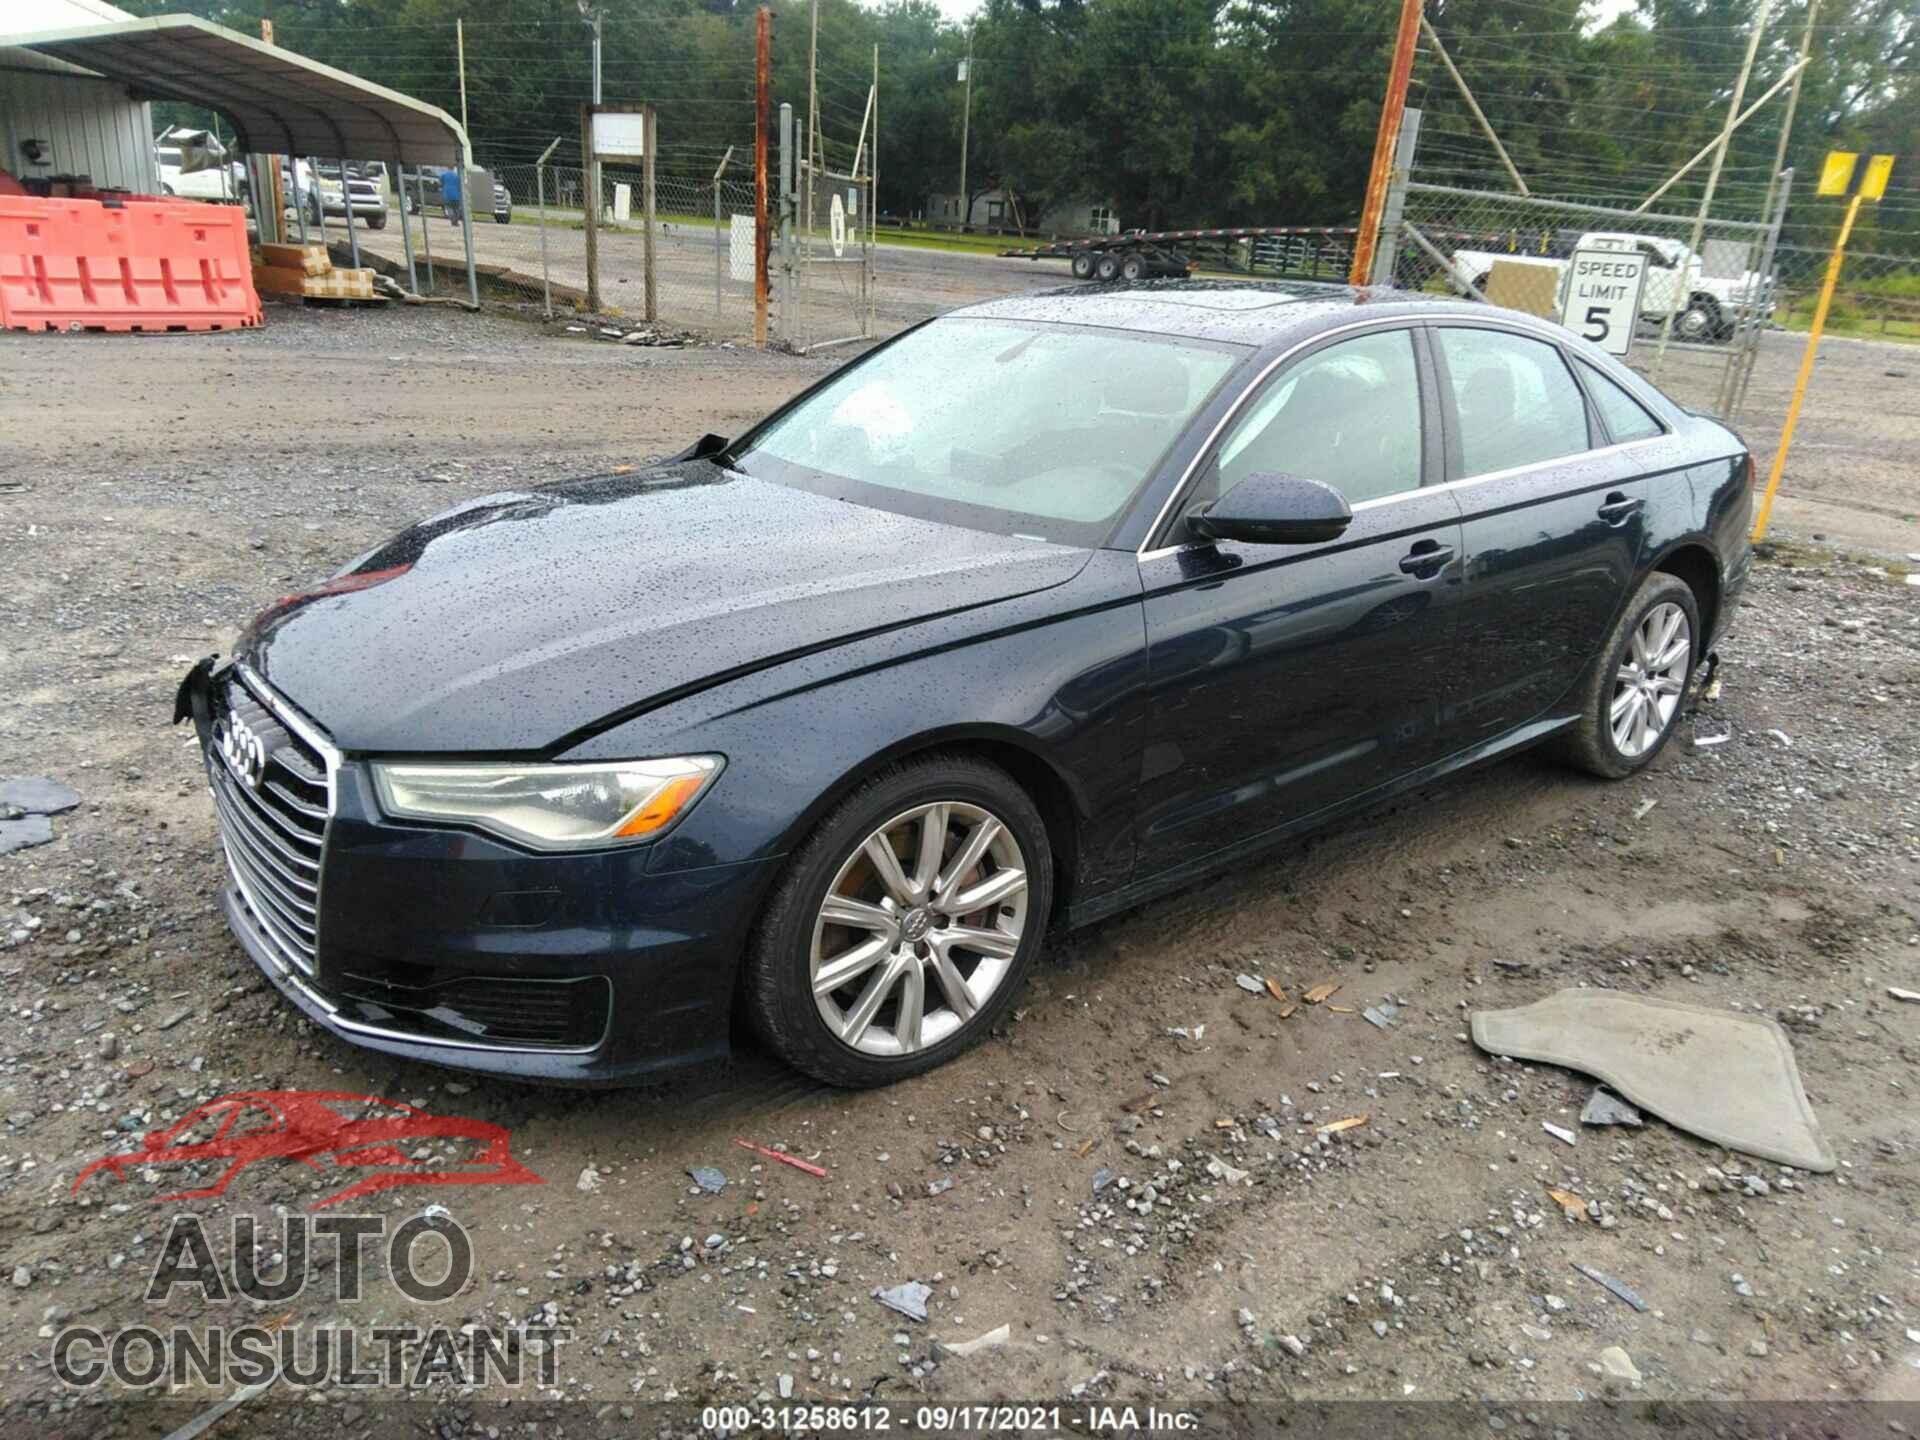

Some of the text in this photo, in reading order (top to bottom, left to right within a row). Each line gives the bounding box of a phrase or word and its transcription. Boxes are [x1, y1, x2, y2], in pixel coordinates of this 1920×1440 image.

[1577, 261, 1639, 279] SPEED
[1578, 283, 1628, 300] LIMIT
[1582, 306, 1611, 342] 5
